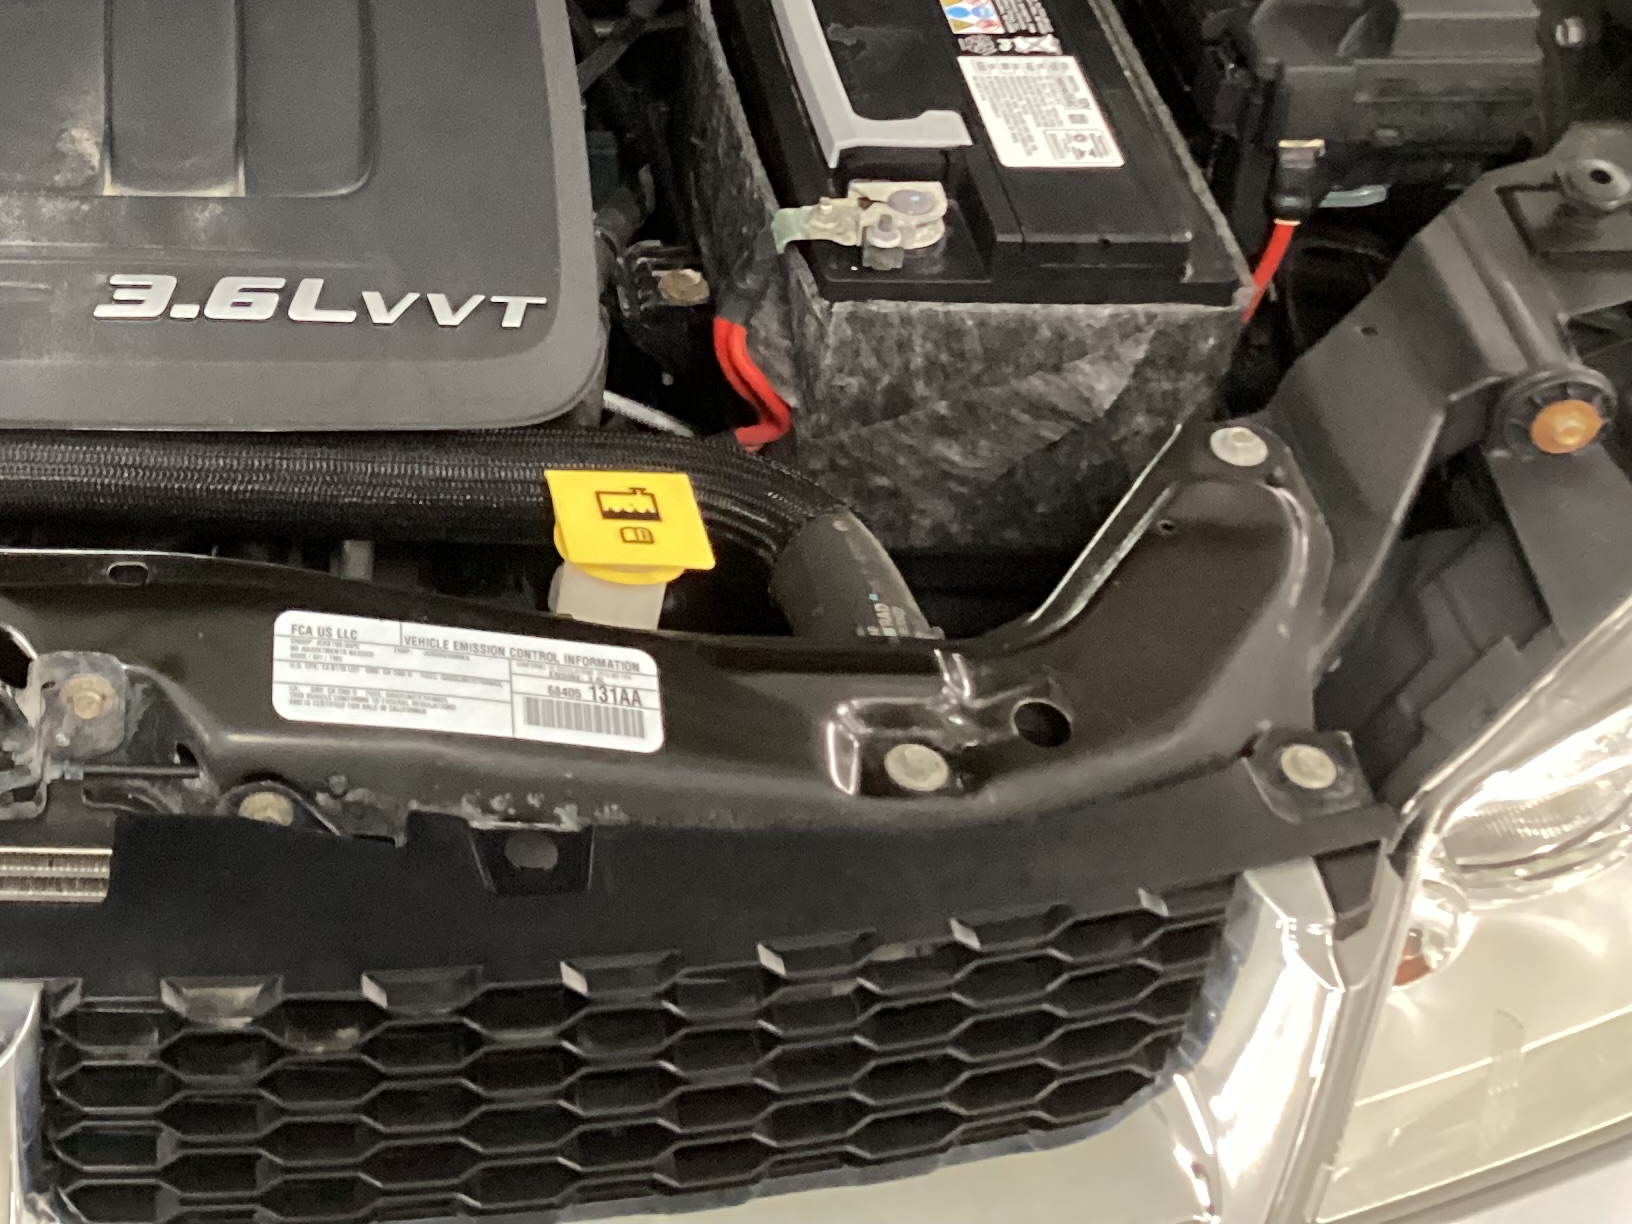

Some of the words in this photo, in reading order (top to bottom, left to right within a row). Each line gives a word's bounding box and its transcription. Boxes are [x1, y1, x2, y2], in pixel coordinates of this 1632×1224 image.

[291, 624, 313, 636] FCA
[317, 627, 332, 638] US
[337, 630, 358, 640] LLC
[405, 636, 449, 650] VEHICLE
[453, 640, 505, 656] EMISSION
[509, 648, 559, 663] CONTROL
[563, 654, 640, 672] INFORMATION
[548, 685, 581, 698] 68405
[589, 684, 642, 706] 131AA
